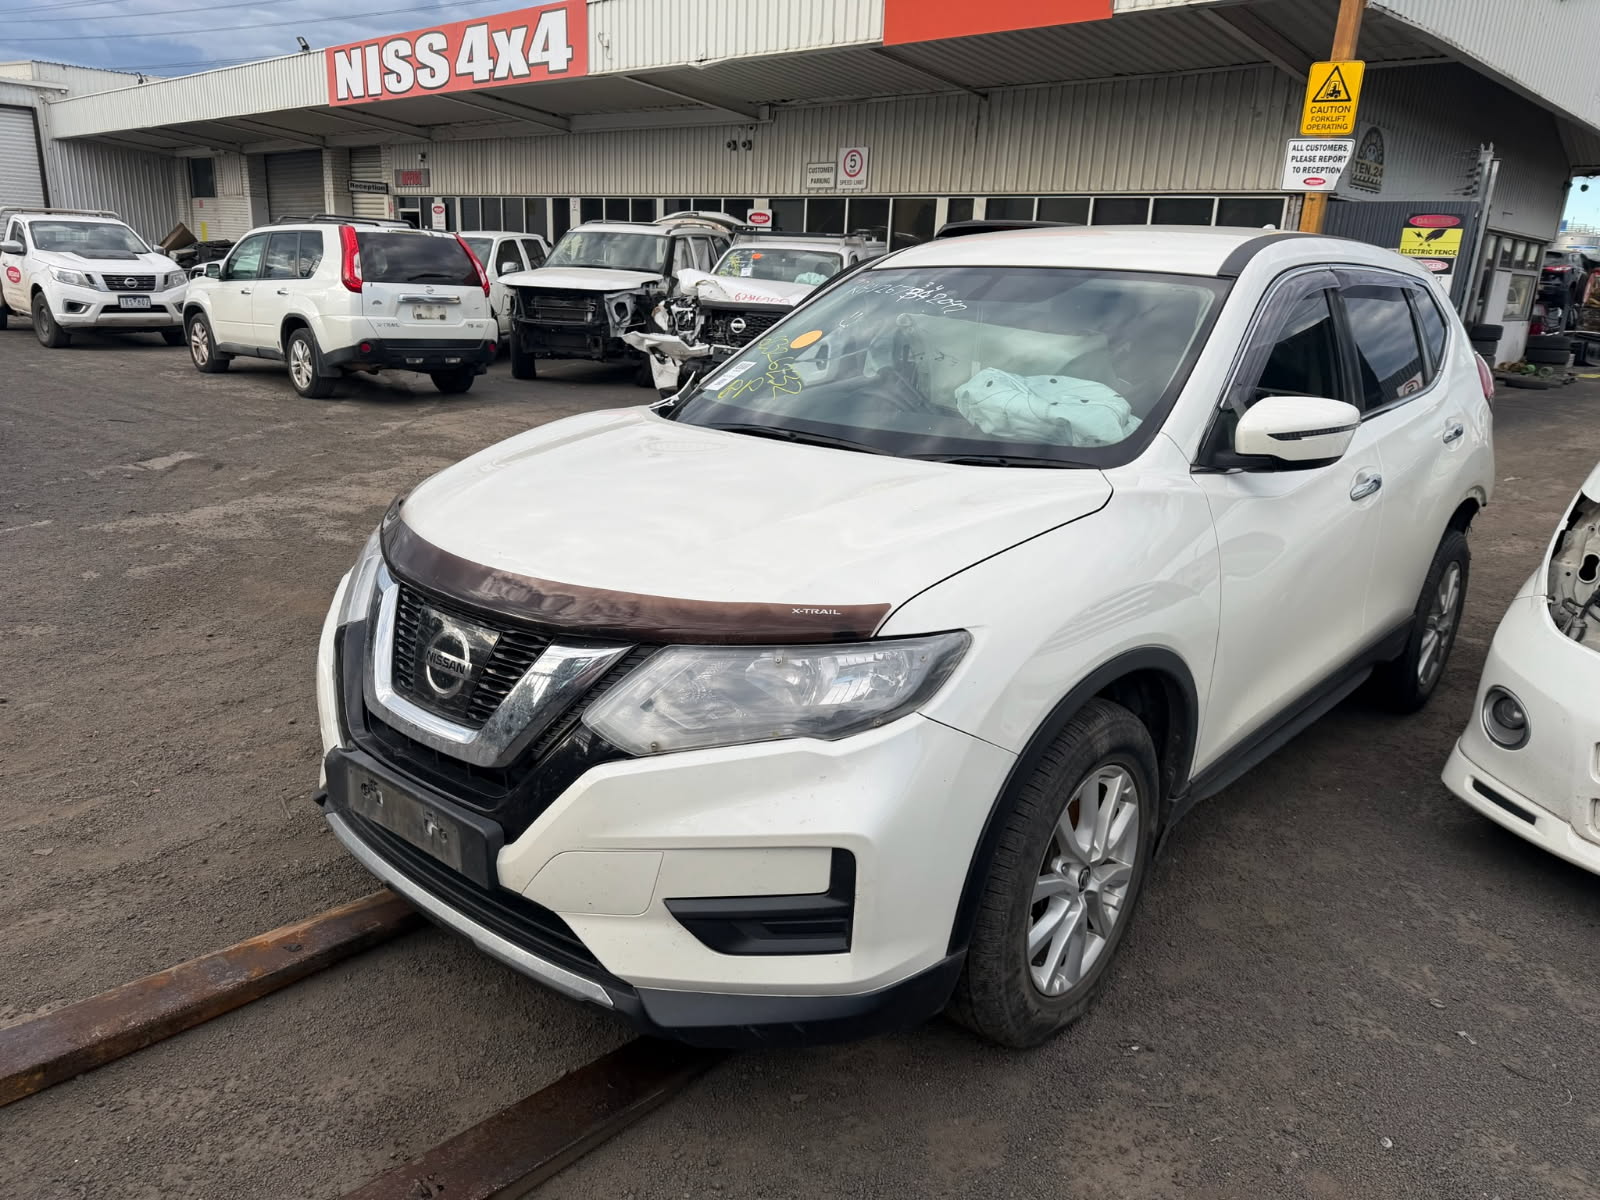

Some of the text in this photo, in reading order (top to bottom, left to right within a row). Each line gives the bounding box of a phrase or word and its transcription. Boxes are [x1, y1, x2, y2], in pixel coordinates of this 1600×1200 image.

[334, 8, 573, 101] NISS 4x4
[1310, 106, 1351, 114] CAUTION
[1306, 123, 1348, 131] OPERATING
[1292, 144, 1349, 152] ALL CUSTOMERS,
[849, 153, 857, 168] 5
[1290, 155, 1347, 163] PLEASE REPORT
[1292, 166, 1341, 174] TO RECEPTION
[349, 183, 386, 192] Reception
[427, 650, 466, 675] NISSAN
